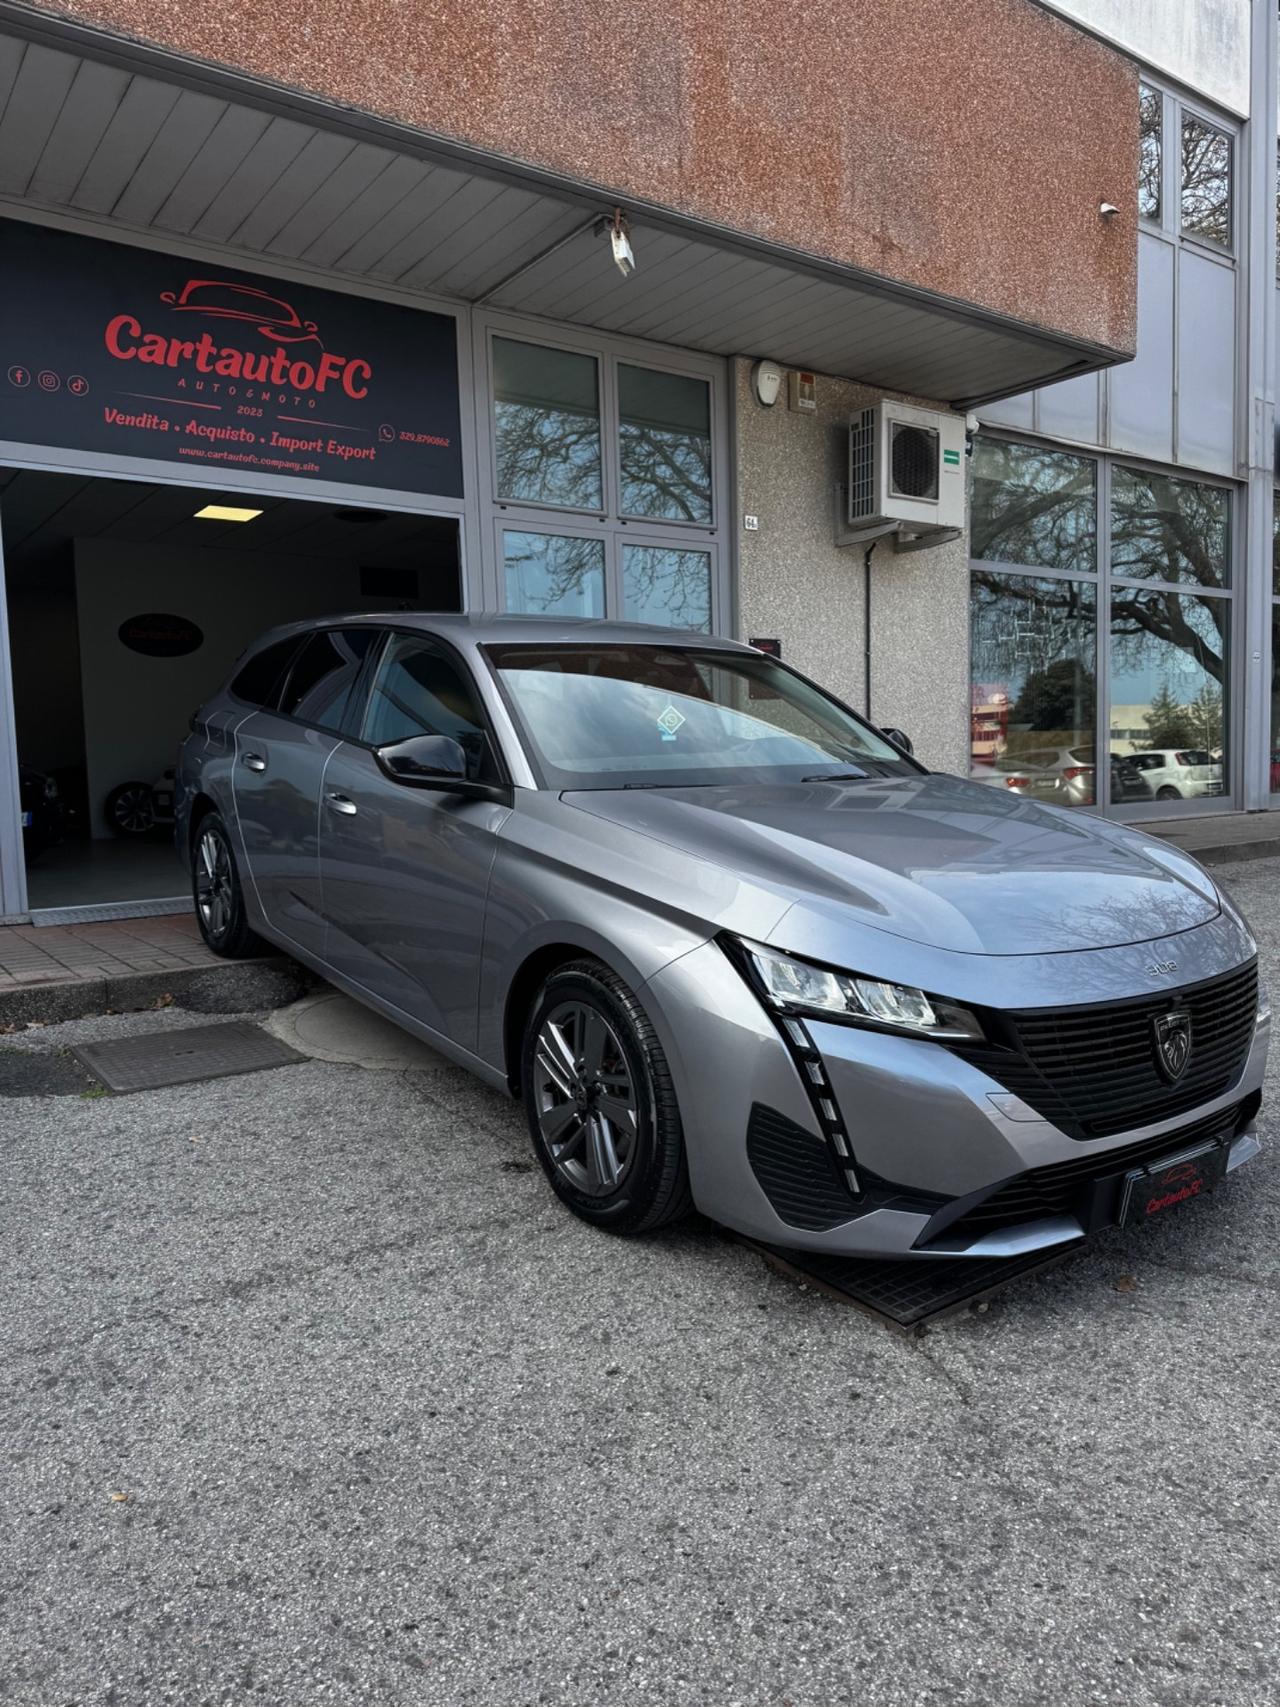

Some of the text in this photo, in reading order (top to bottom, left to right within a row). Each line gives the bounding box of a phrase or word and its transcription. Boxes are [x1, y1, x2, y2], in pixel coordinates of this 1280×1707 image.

[104, 315, 373, 400] CartautoFC
[104, 407, 376, 461] Vendita Acquisto Import Export
[178, 447, 320, 472] www.cartautofc.company.site
